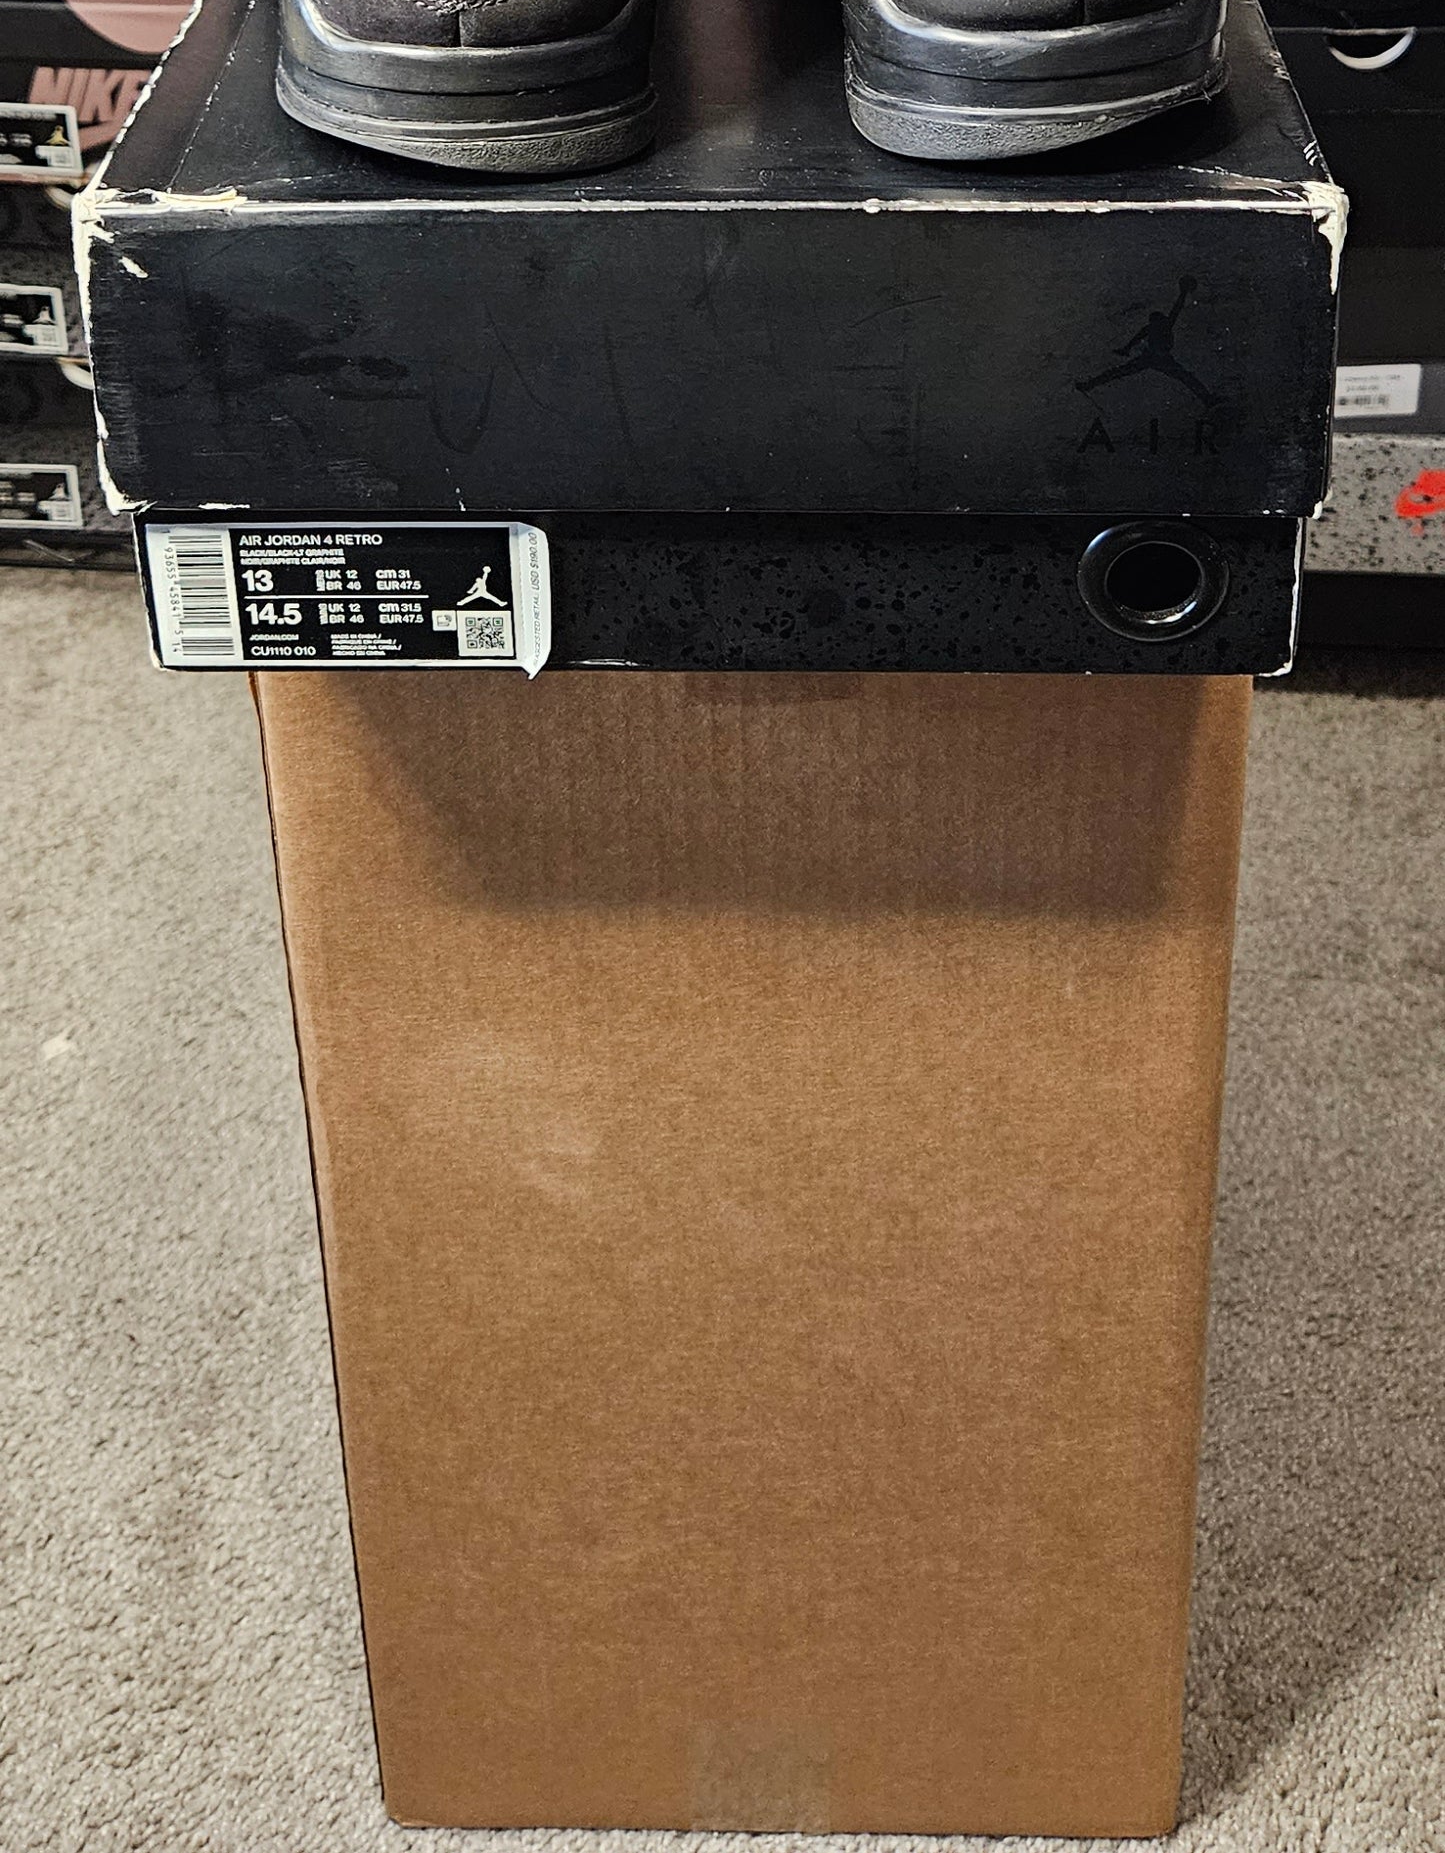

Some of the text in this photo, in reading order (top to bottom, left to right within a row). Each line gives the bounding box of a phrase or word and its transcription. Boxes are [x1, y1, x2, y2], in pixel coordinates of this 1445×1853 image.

[1076, 415, 1221, 454] AIR
[239, 534, 383, 546] AIR JORDAN 4 RETRO
[305, 548, 344, 556] GRAPHITE
[527, 532, 540, 570] $190.00
[325, 569, 342, 579] UK
[345, 569, 358, 579] 12
[398, 569, 411, 579] 31
[242, 569, 274, 592] 13
[326, 580, 421, 590] BR 46 EUR 47.5
[529, 571, 540, 591] USD
[245, 602, 302, 625] 14.5
[328, 603, 345, 613] UK
[348, 603, 361, 613] 12
[400, 603, 422, 612] 31.5
[329, 614, 424, 624] BR 46 EUR 47.5
[251, 646, 316, 656] CU1110 010
